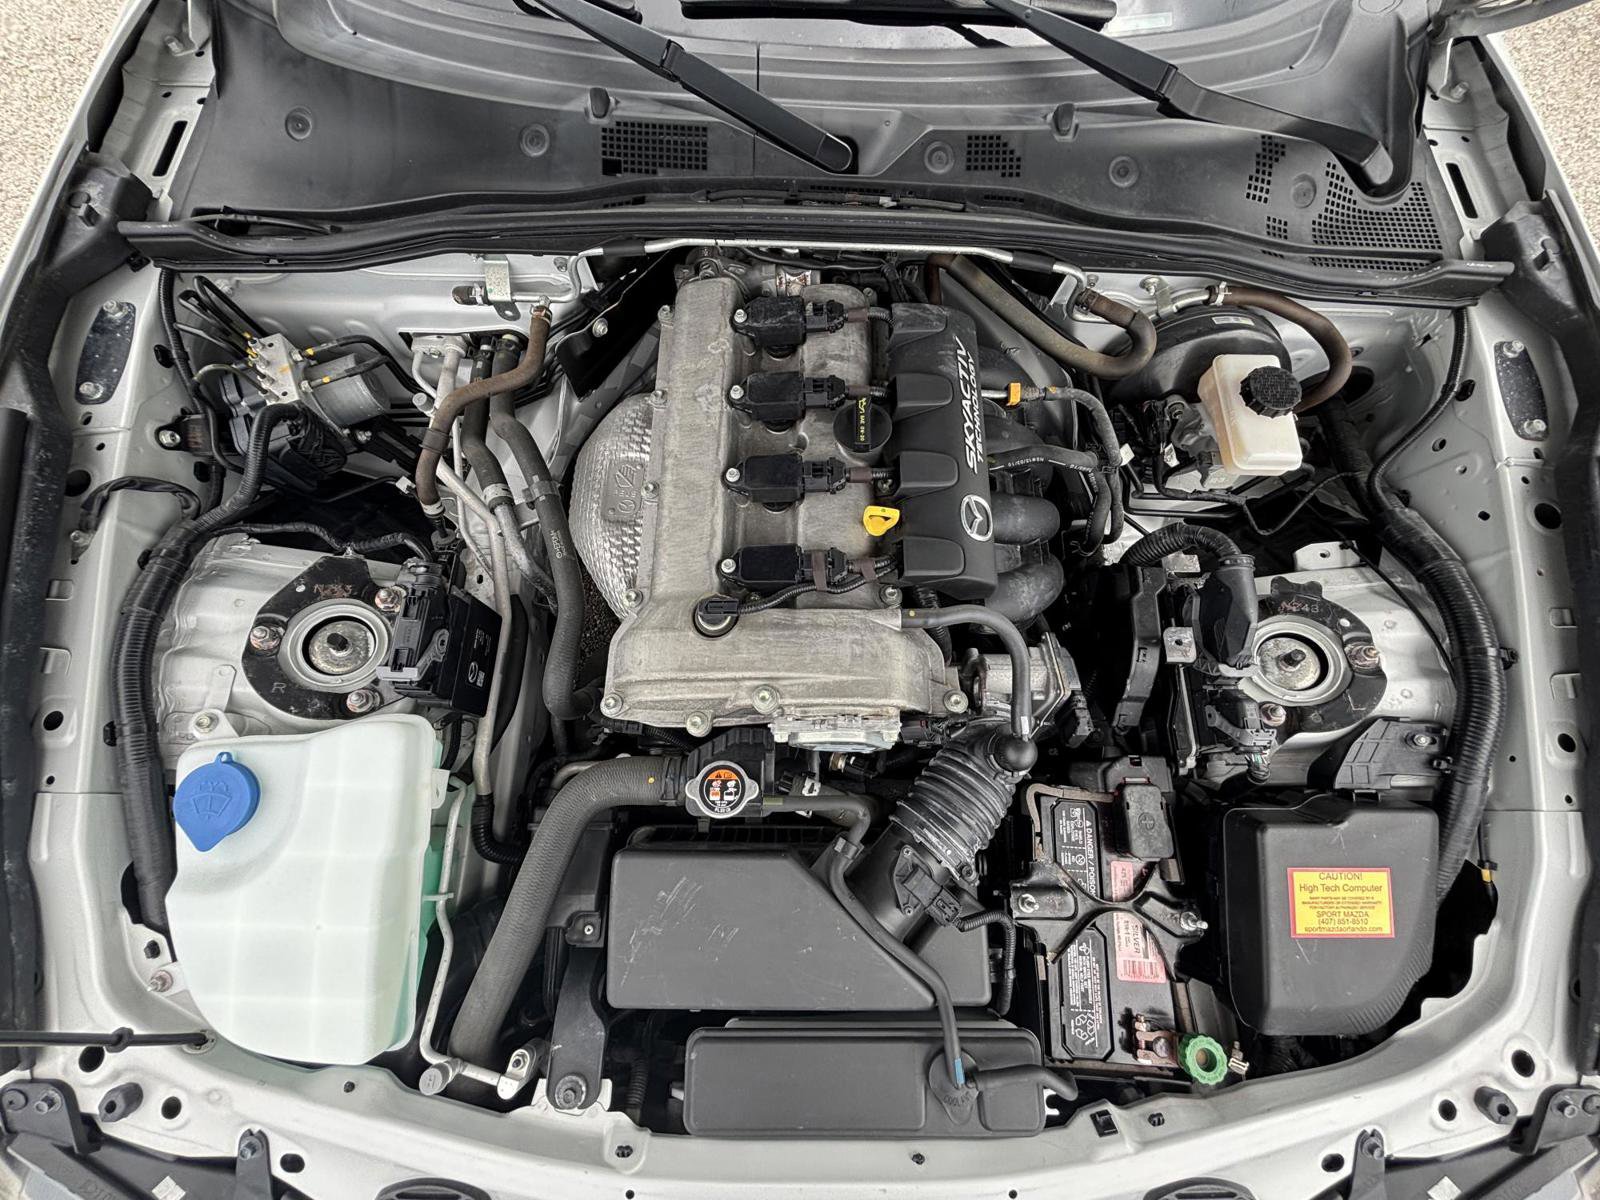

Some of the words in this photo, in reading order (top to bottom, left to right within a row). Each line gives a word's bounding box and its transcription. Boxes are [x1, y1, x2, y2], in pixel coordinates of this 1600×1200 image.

[953, 334, 978, 475] SKYACTIV
[966, 351, 984, 463] TECHNOLOGY
[1086, 827, 1094, 859] DANGER
[1300, 884, 1319, 893] High
[1320, 884, 1340, 892] Tech
[1342, 884, 1382, 893] Computer
[1319, 872, 1363, 880] CAUTION!
